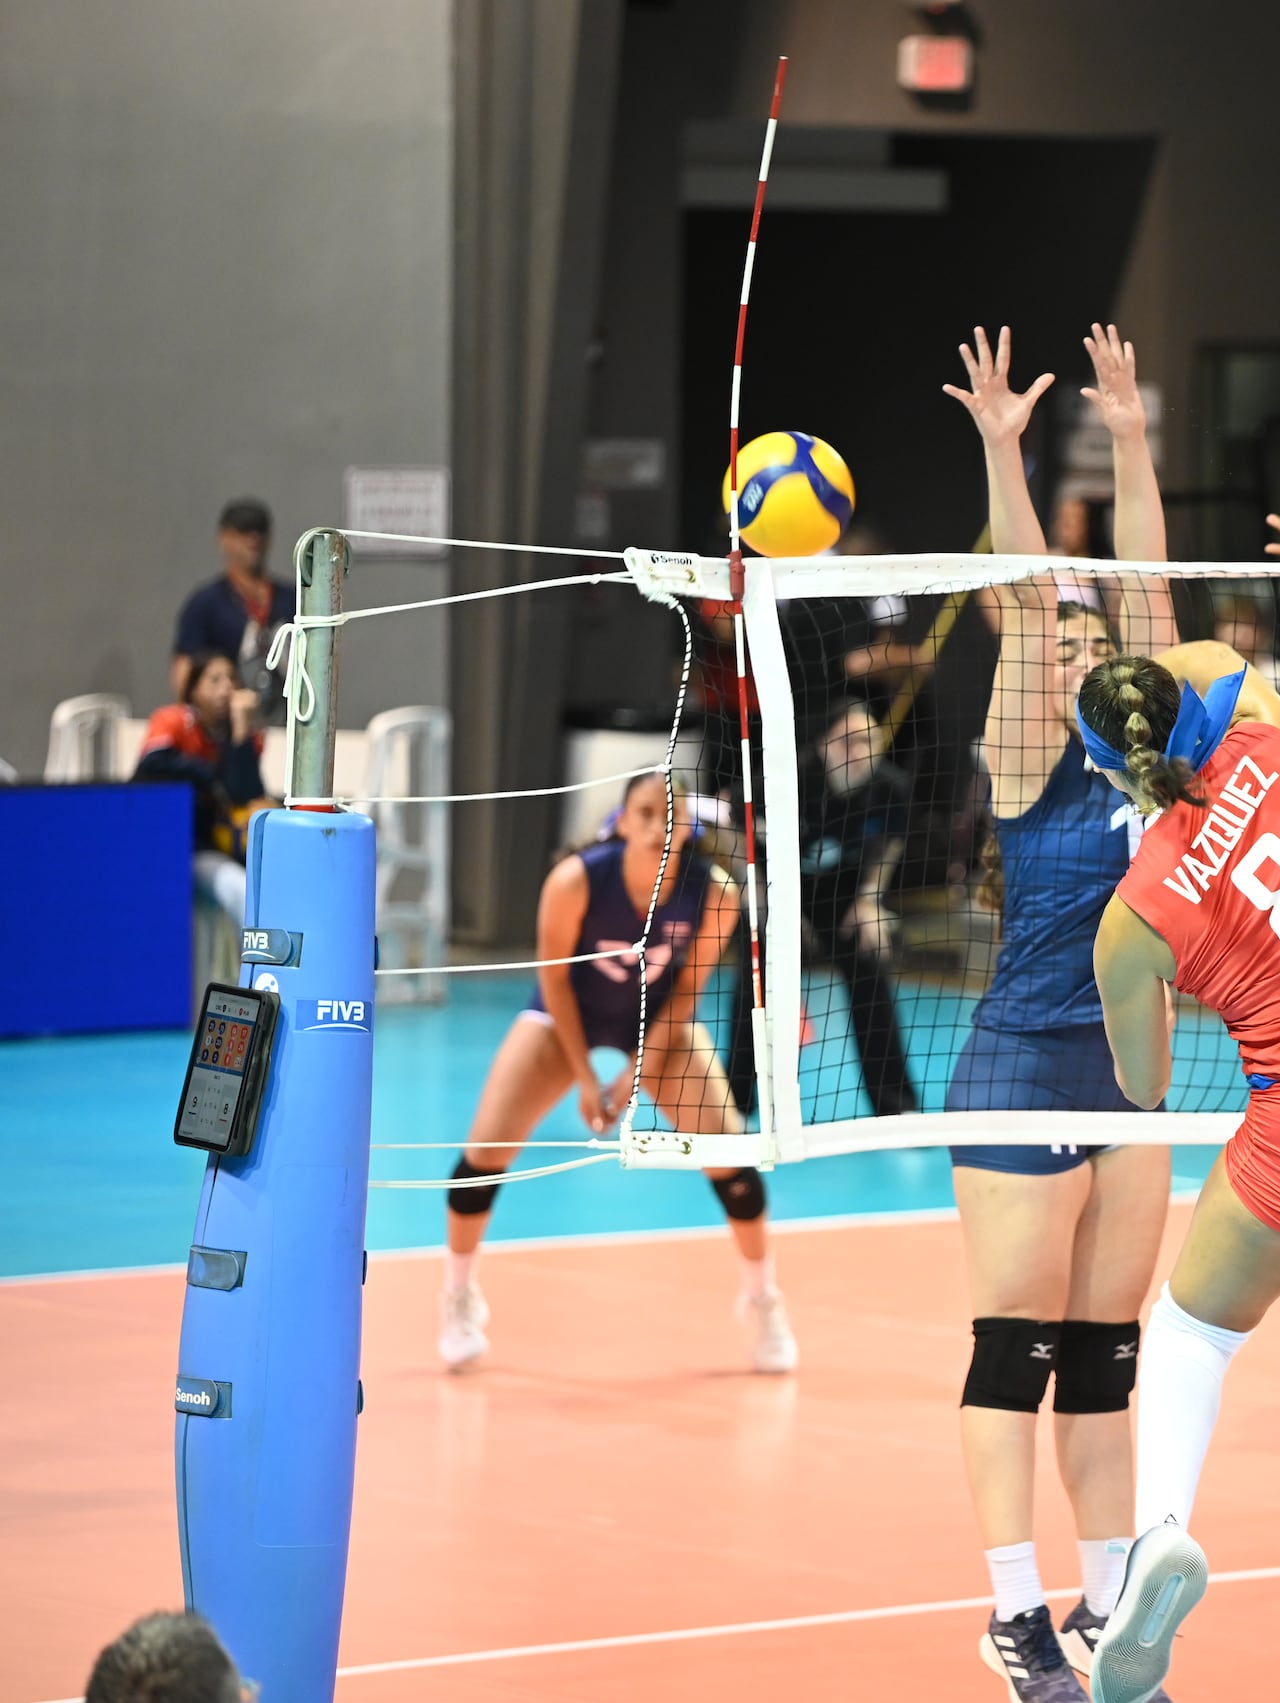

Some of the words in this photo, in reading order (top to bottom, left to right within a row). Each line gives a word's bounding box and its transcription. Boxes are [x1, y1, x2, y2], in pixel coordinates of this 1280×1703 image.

[660, 555, 692, 565] Senoh
[1162, 755, 1280, 905] VAZQUEZ
[243, 931, 269, 950] FIVB
[316, 1000, 365, 1021] FIVB
[175, 1387, 211, 1406] Senoh
